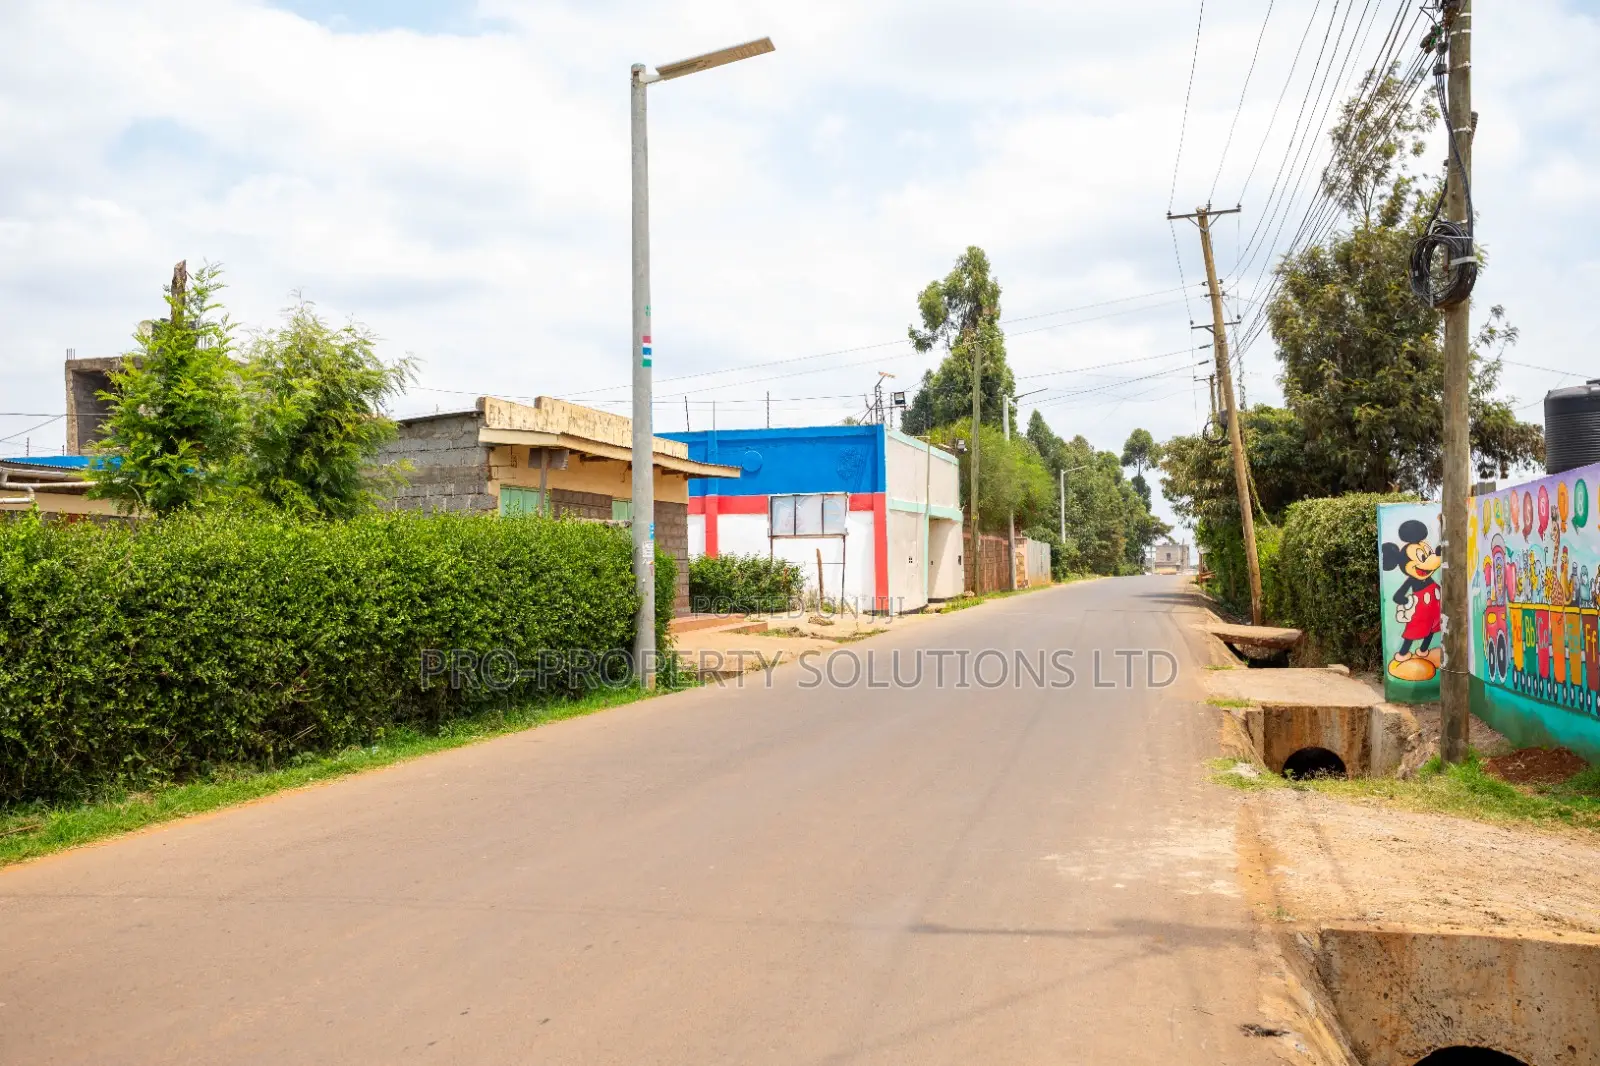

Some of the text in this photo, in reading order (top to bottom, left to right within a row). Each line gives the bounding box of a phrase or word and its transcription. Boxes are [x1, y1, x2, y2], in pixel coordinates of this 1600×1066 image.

[1576, 491, 1584, 516] 8
[1525, 616, 1536, 648] Bb
[1585, 623, 1597, 663] Ff
